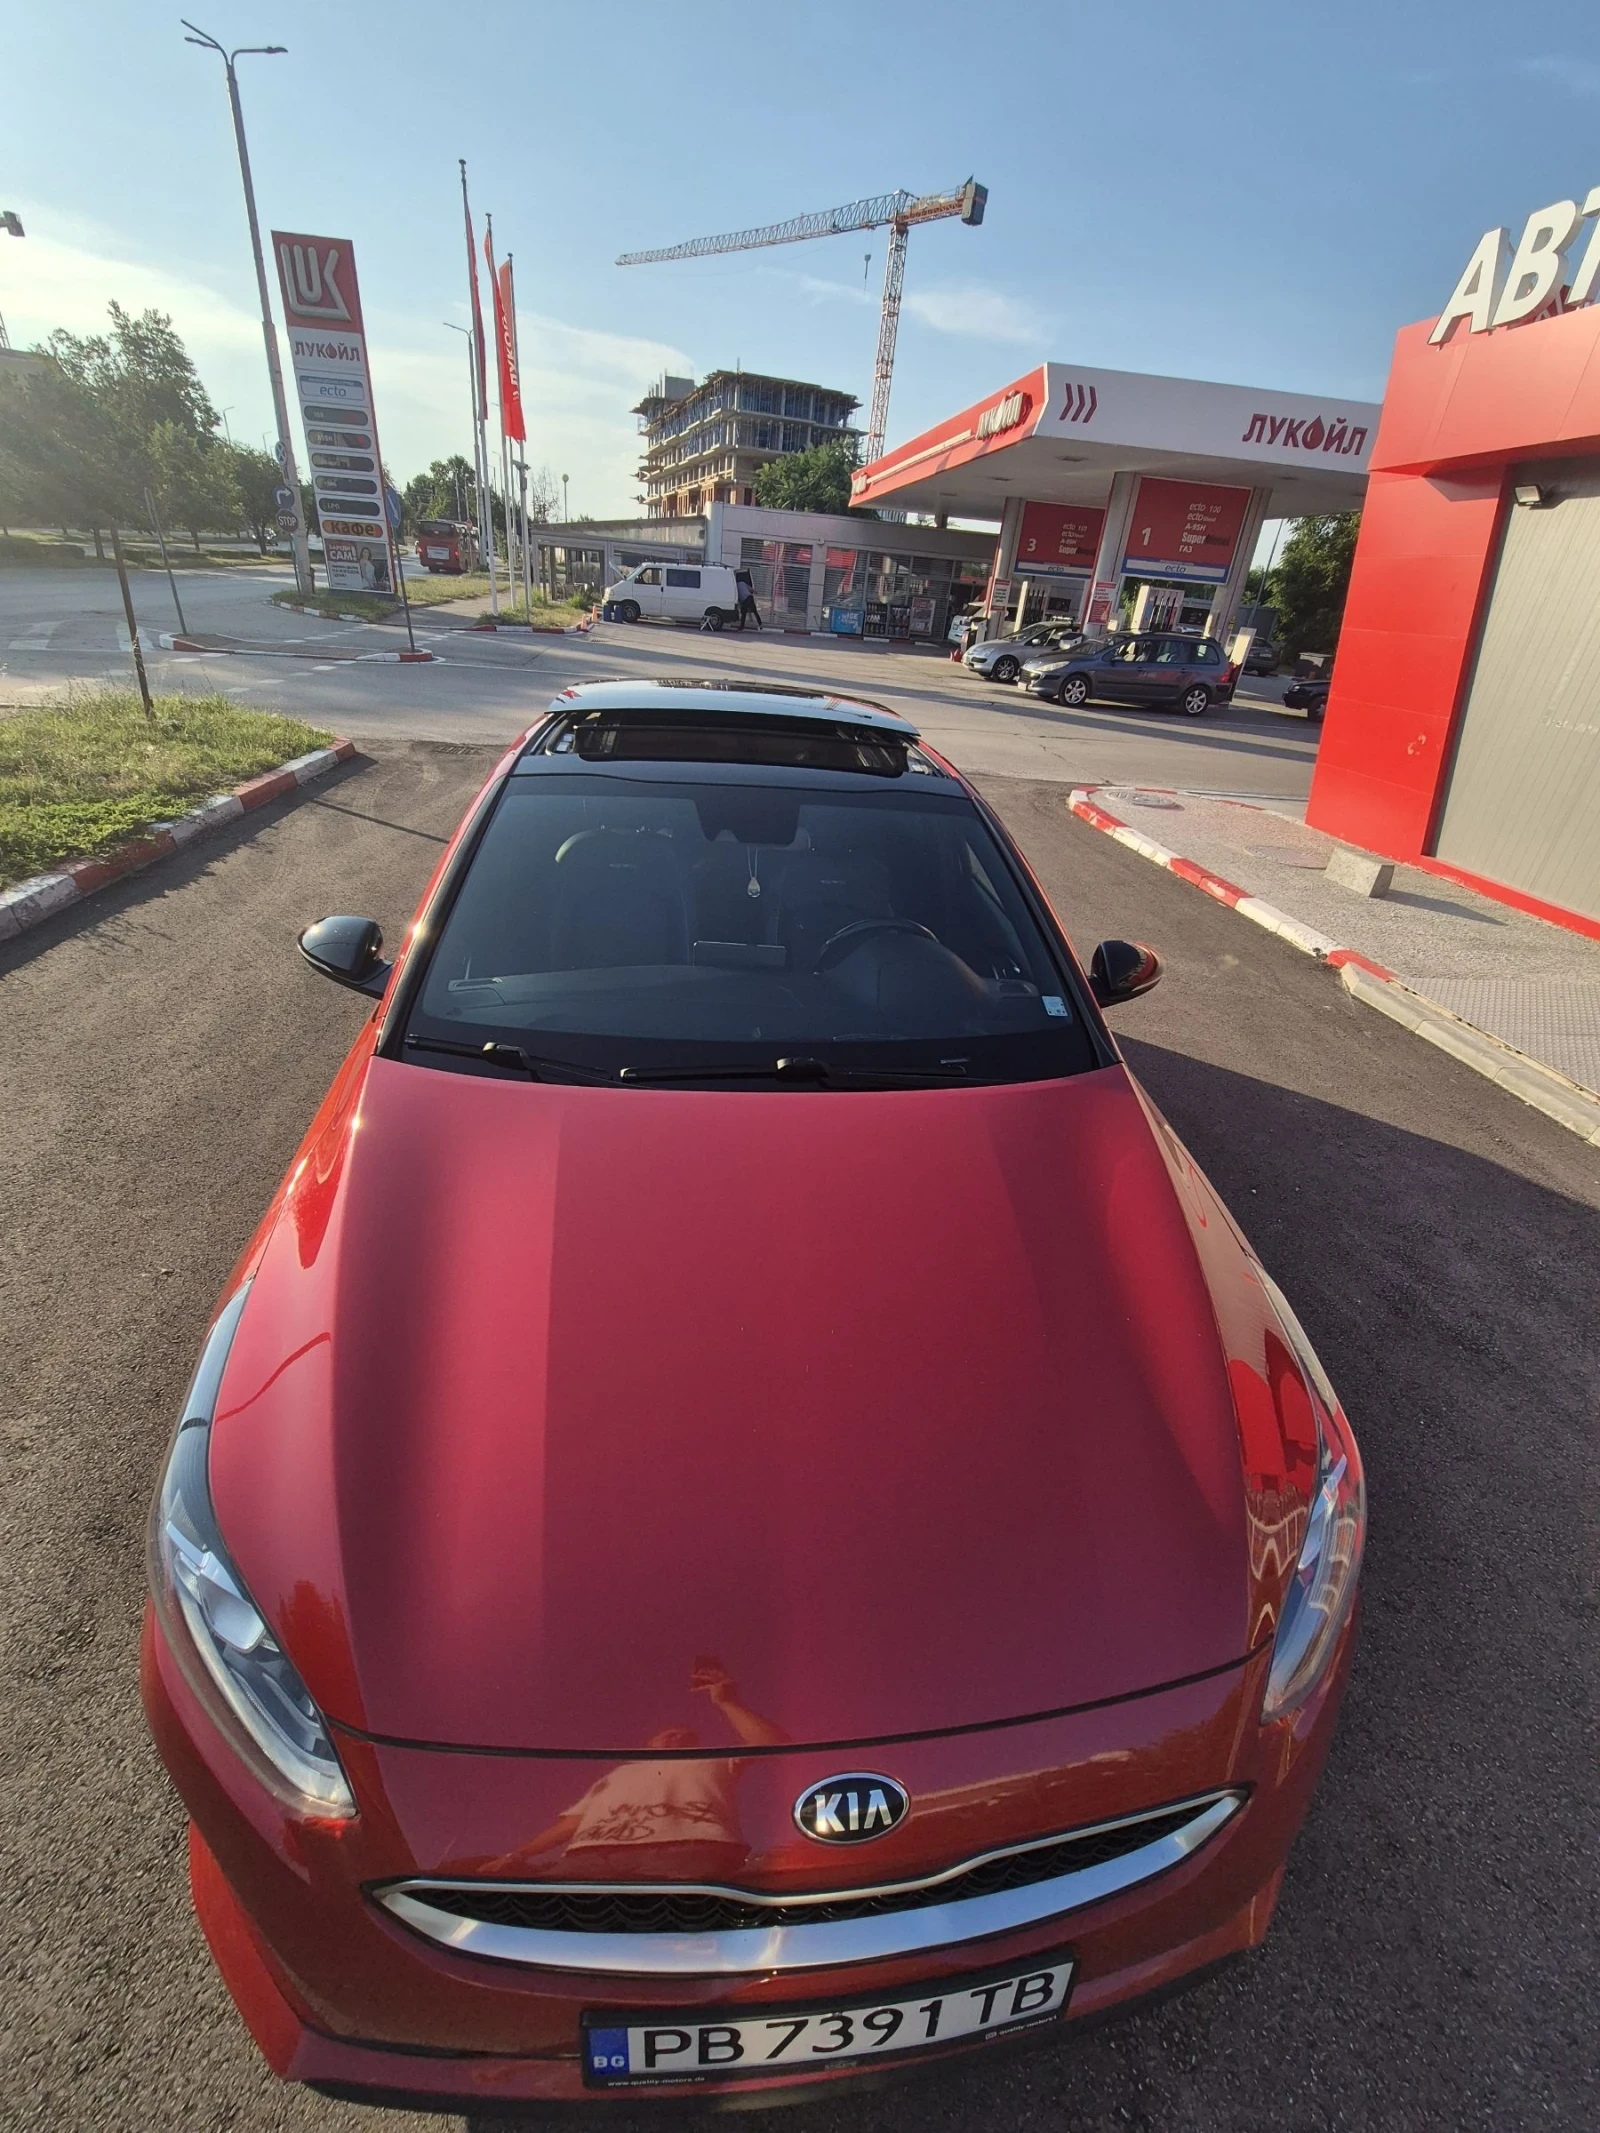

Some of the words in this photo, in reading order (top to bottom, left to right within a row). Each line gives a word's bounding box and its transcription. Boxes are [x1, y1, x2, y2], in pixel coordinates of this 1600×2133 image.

[319, 385, 347, 397] ecto
[1189, 502, 1206, 512] ecto
[278, 516, 297, 527] STOP
[1141, 527, 1152, 546] 1
[1181, 531, 1206, 545] Super
[1027, 538, 1037, 552] 3
[1165, 564, 1187, 573] ecto
[814, 1788, 893, 1833] KIA
[643, 2026, 744, 2069] PB
[764, 1999, 944, 2061] 7391
[970, 1972, 1056, 2026] TB
[592, 2054, 626, 2069] BG
